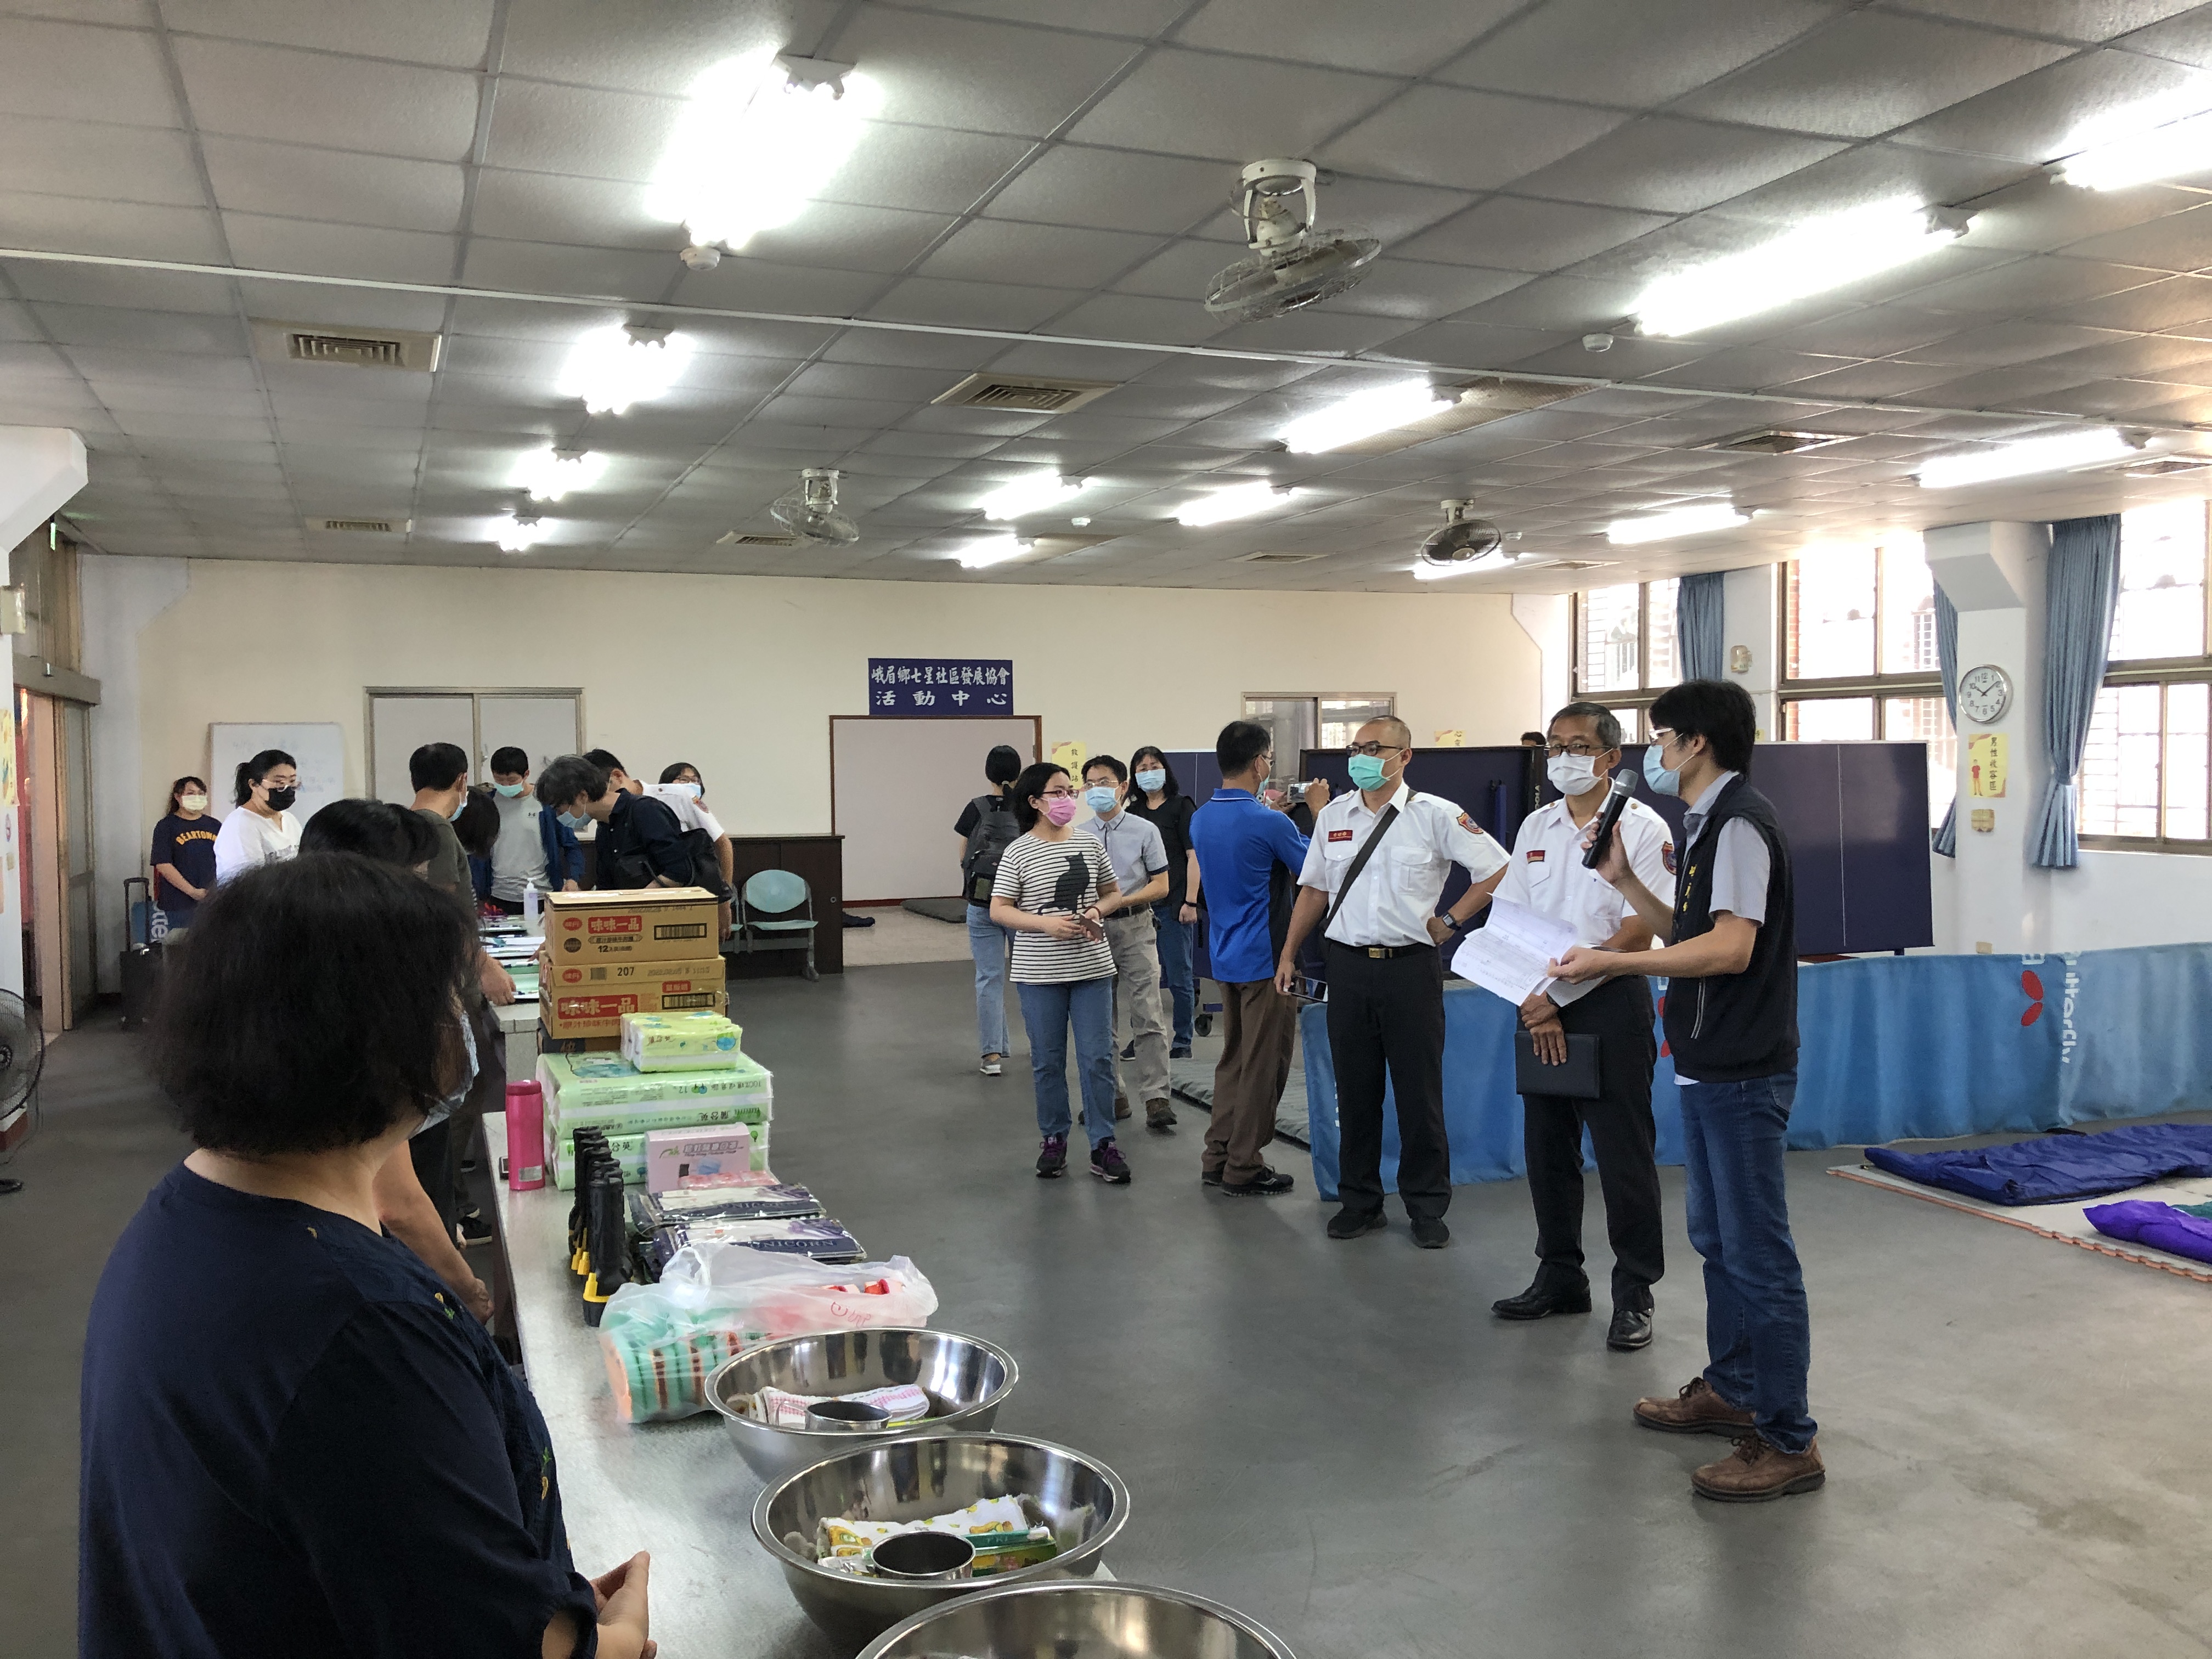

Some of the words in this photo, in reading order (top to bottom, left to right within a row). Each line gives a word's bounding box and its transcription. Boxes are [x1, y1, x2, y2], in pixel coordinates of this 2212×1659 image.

[871, 665, 1010, 685] 峨眉鄉七星社區發展協會
[876, 690, 1007, 706] 活動中心
[1989, 737, 1998, 791] 男性收容區
[591, 918, 639, 932] 味味一品
[617, 967, 635, 977] 207
[561, 997, 635, 1015] 味味一品
[611, 1141, 633, 1152] 公英
